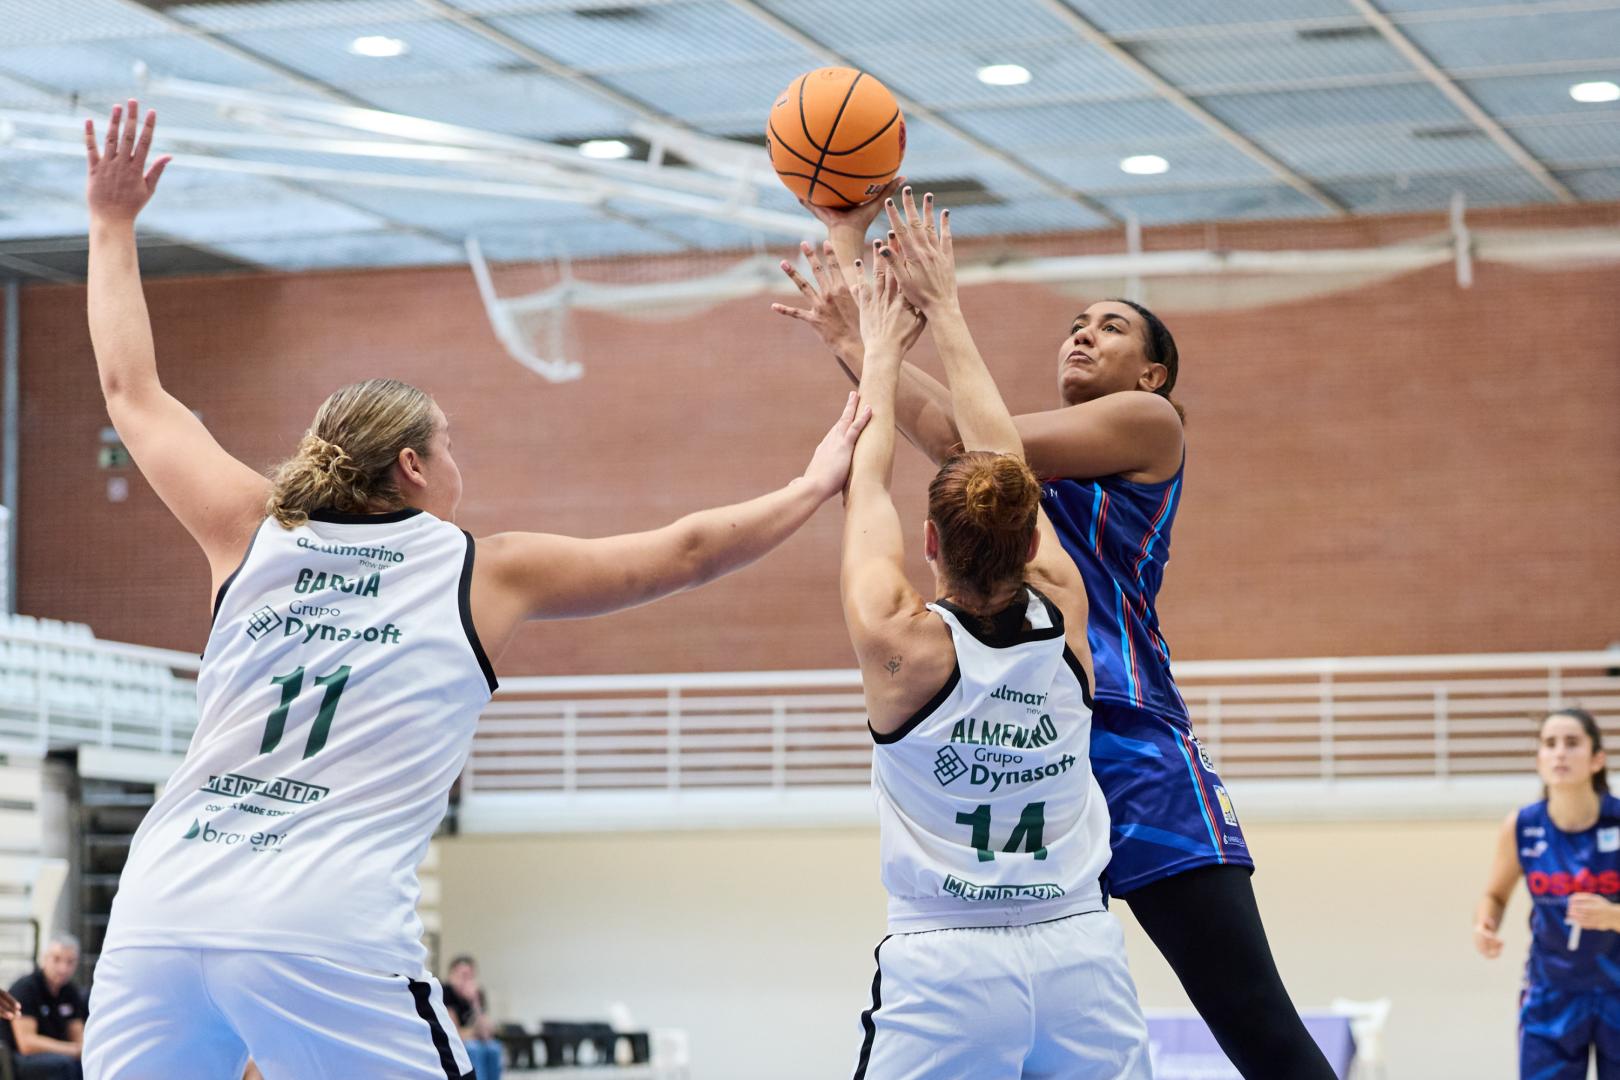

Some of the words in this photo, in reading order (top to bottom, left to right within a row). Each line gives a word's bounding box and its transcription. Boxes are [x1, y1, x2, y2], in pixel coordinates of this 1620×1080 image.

[289, 600, 341, 617] Grupo
[259, 665, 352, 760] 11
[974, 748, 1024, 767] Grupo
[969, 754, 1076, 793] Dynasoft
[239, 803, 266, 815] MADE
[955, 801, 1048, 862] 14
